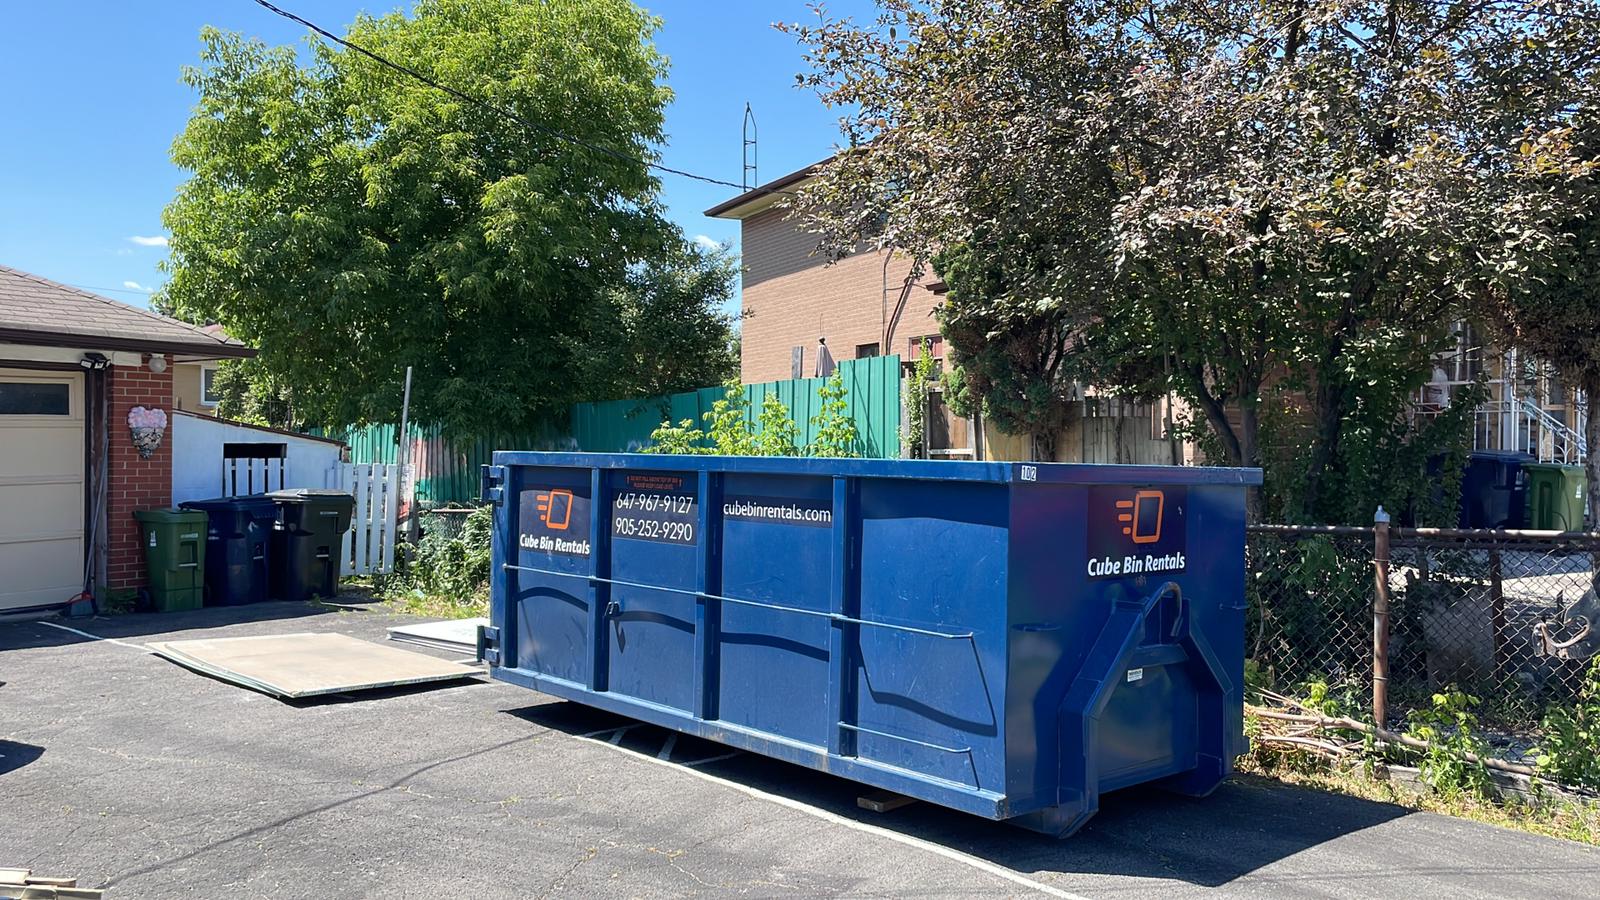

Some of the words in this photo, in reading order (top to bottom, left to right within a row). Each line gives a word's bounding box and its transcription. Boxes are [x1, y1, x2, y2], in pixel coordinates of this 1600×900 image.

[1022, 465, 1037, 481] 102
[616, 492, 694, 514] 647-967-9127
[723, 500, 831, 522] cubebinrentals.com
[615, 517, 693, 541] 905-252-9290
[520, 533, 539, 548] Cube
[539, 535, 554, 551] Bin
[554, 537, 591, 555] Rentals
[1087, 556, 1121, 577] Cube
[1123, 555, 1143, 574] Bin
[1145, 551, 1186, 572] Rentals
